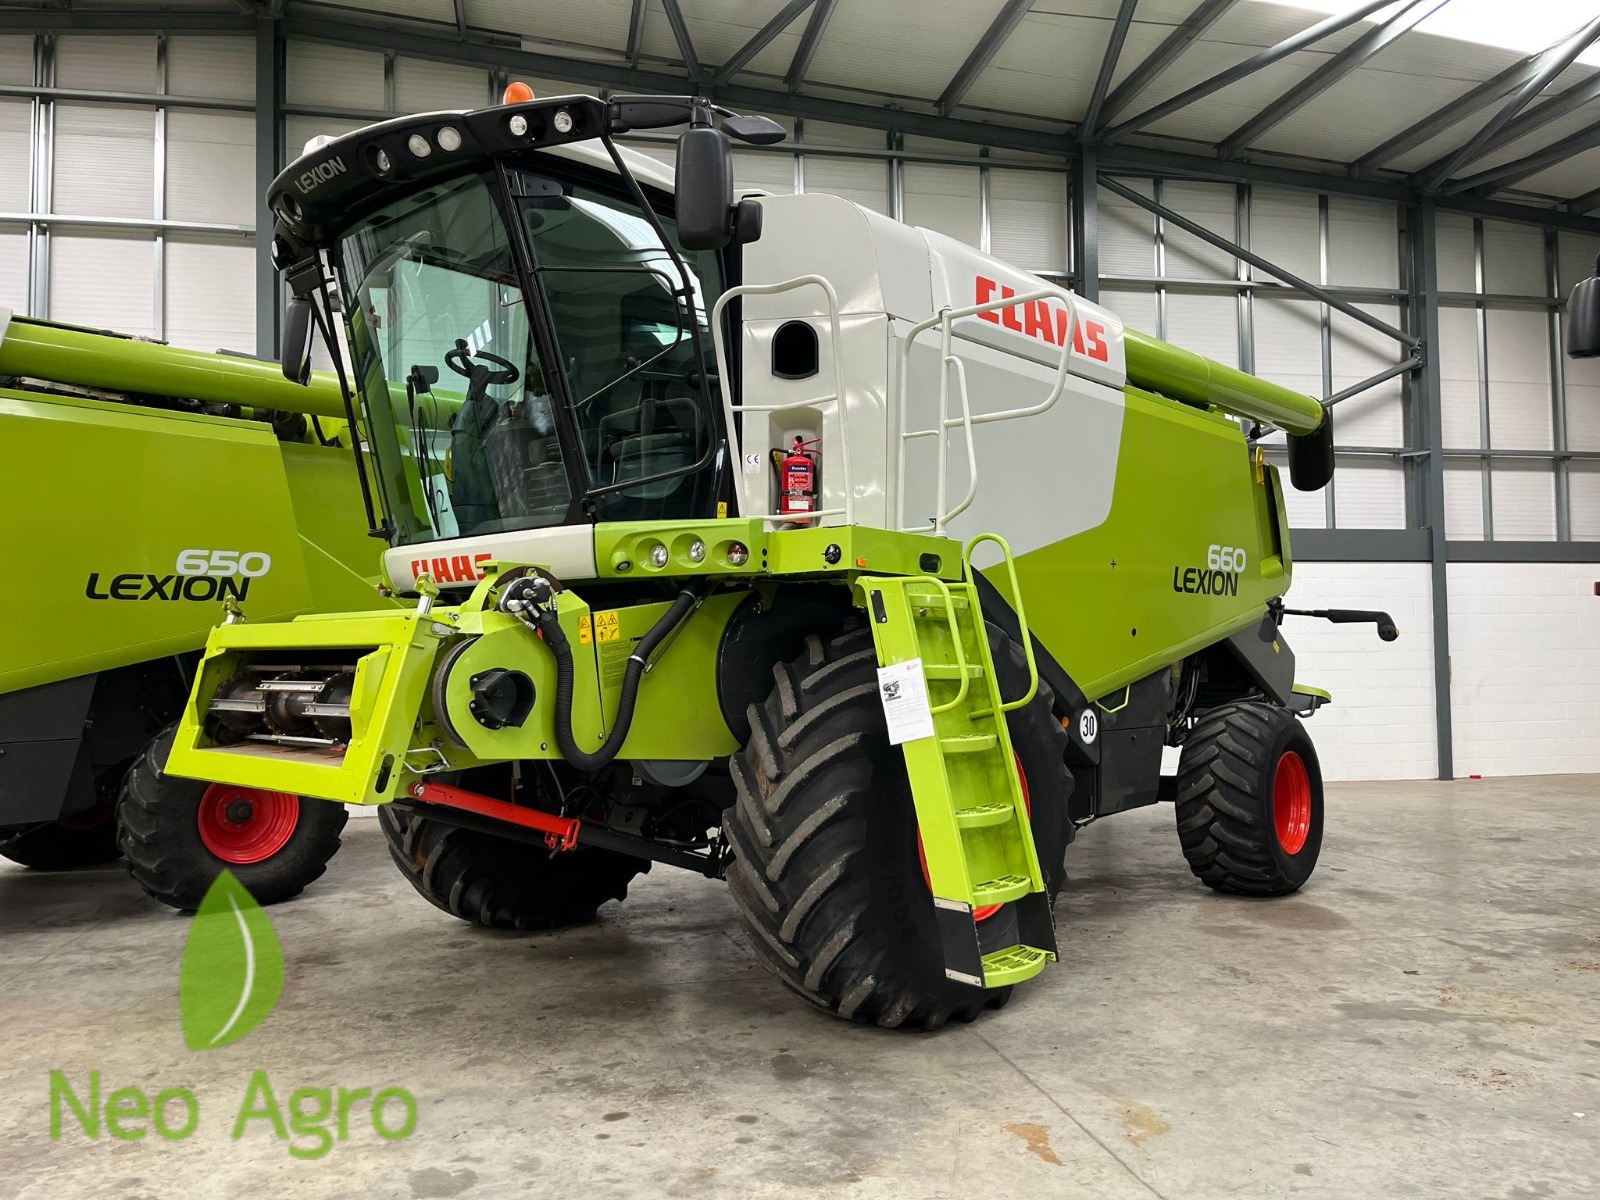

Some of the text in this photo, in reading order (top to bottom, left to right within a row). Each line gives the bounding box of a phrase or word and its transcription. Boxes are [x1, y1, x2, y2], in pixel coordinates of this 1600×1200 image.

[294, 156, 348, 194] LEXION
[975, 275, 1109, 363] CLAAS
[175, 549, 272, 578] 650
[1207, 544, 1247, 573] 660
[85, 572, 251, 602] LEXION
[1173, 566, 1239, 597] LEXION
[1082, 715, 1095, 737] 30
